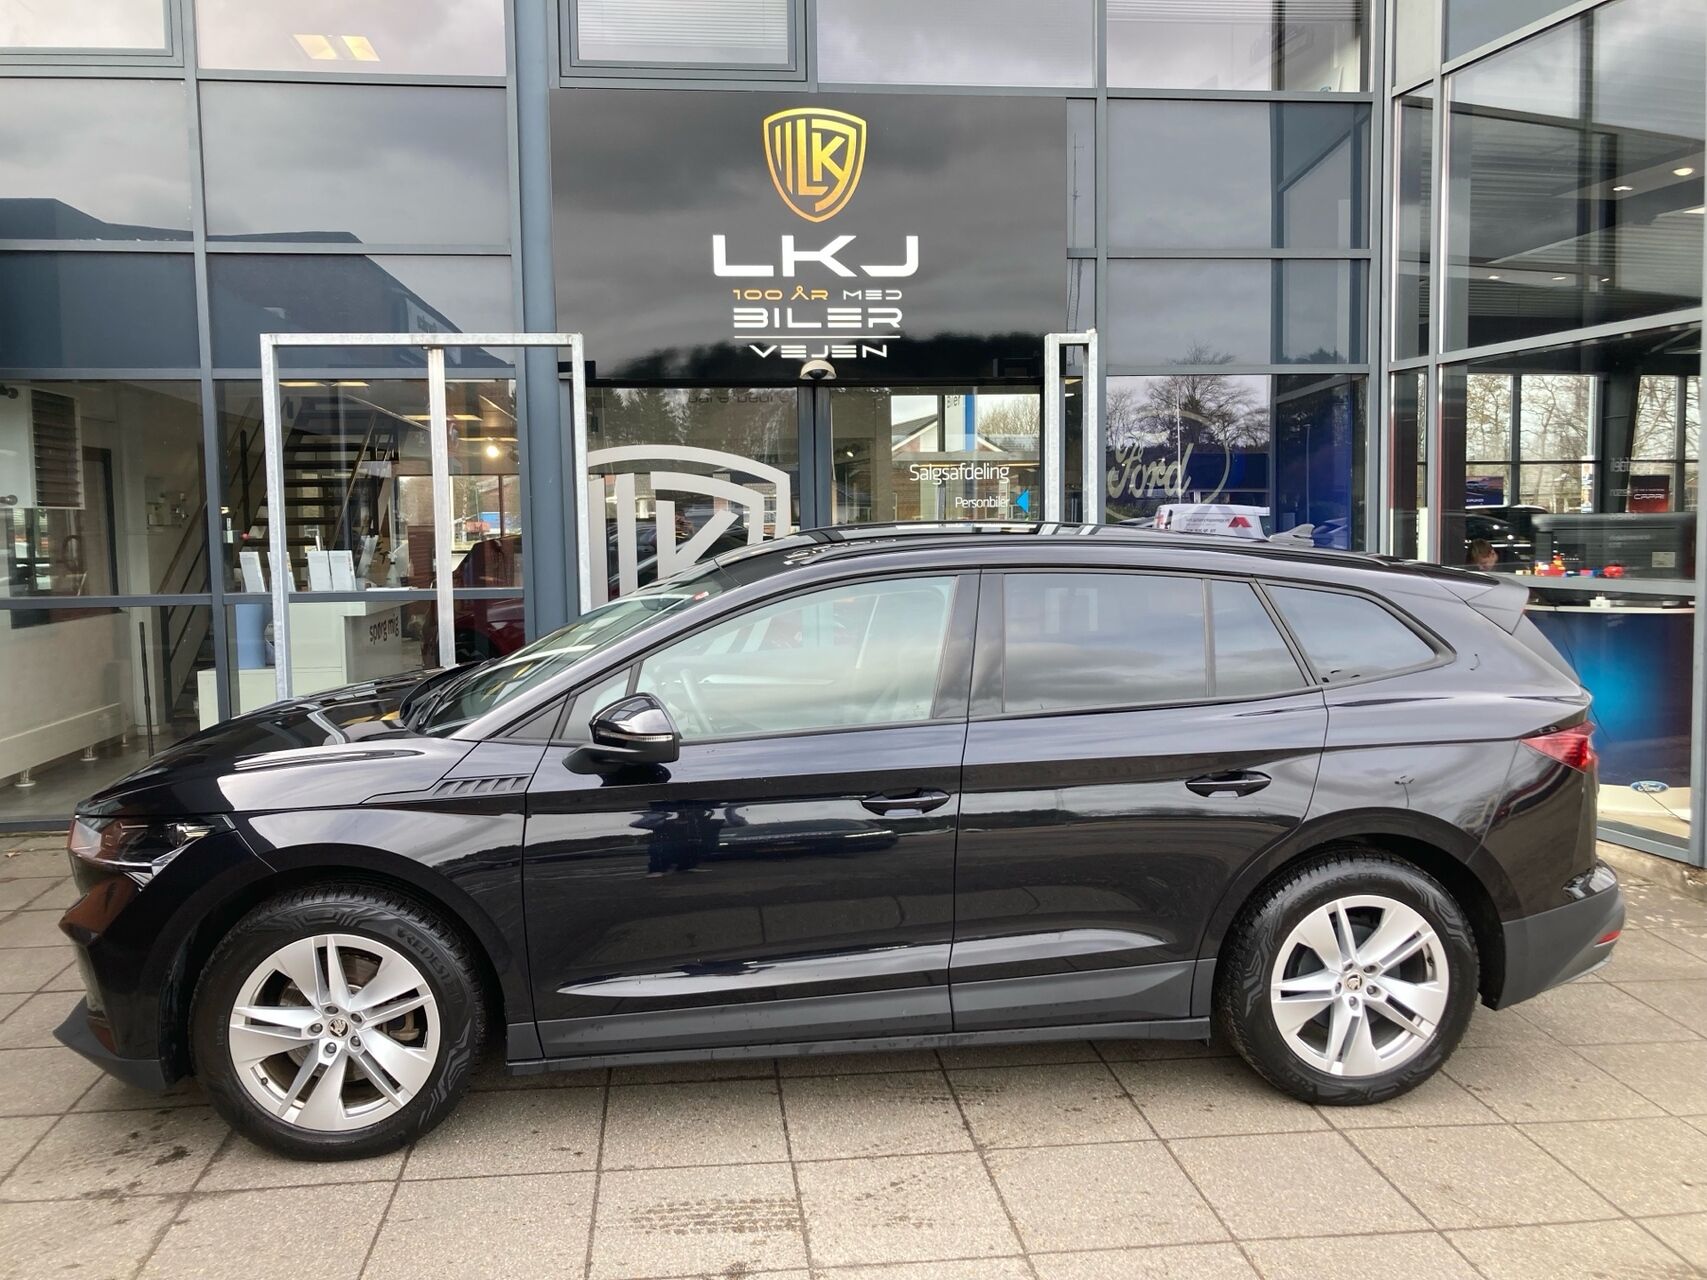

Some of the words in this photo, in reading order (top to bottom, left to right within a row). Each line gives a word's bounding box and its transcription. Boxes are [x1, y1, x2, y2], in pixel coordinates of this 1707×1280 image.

[712, 234, 919, 278] LKJ
[732, 289, 783, 301] 100
[790, 285, 829, 301] ÅR
[843, 289, 903, 301] MED
[733, 307, 903, 329] BILER
[749, 344, 888, 359] VEJEN
[909, 463, 1010, 485] Salgsafdeling
[1107, 431, 1194, 499] Ford
[955, 496, 1010, 509] Personbiler
